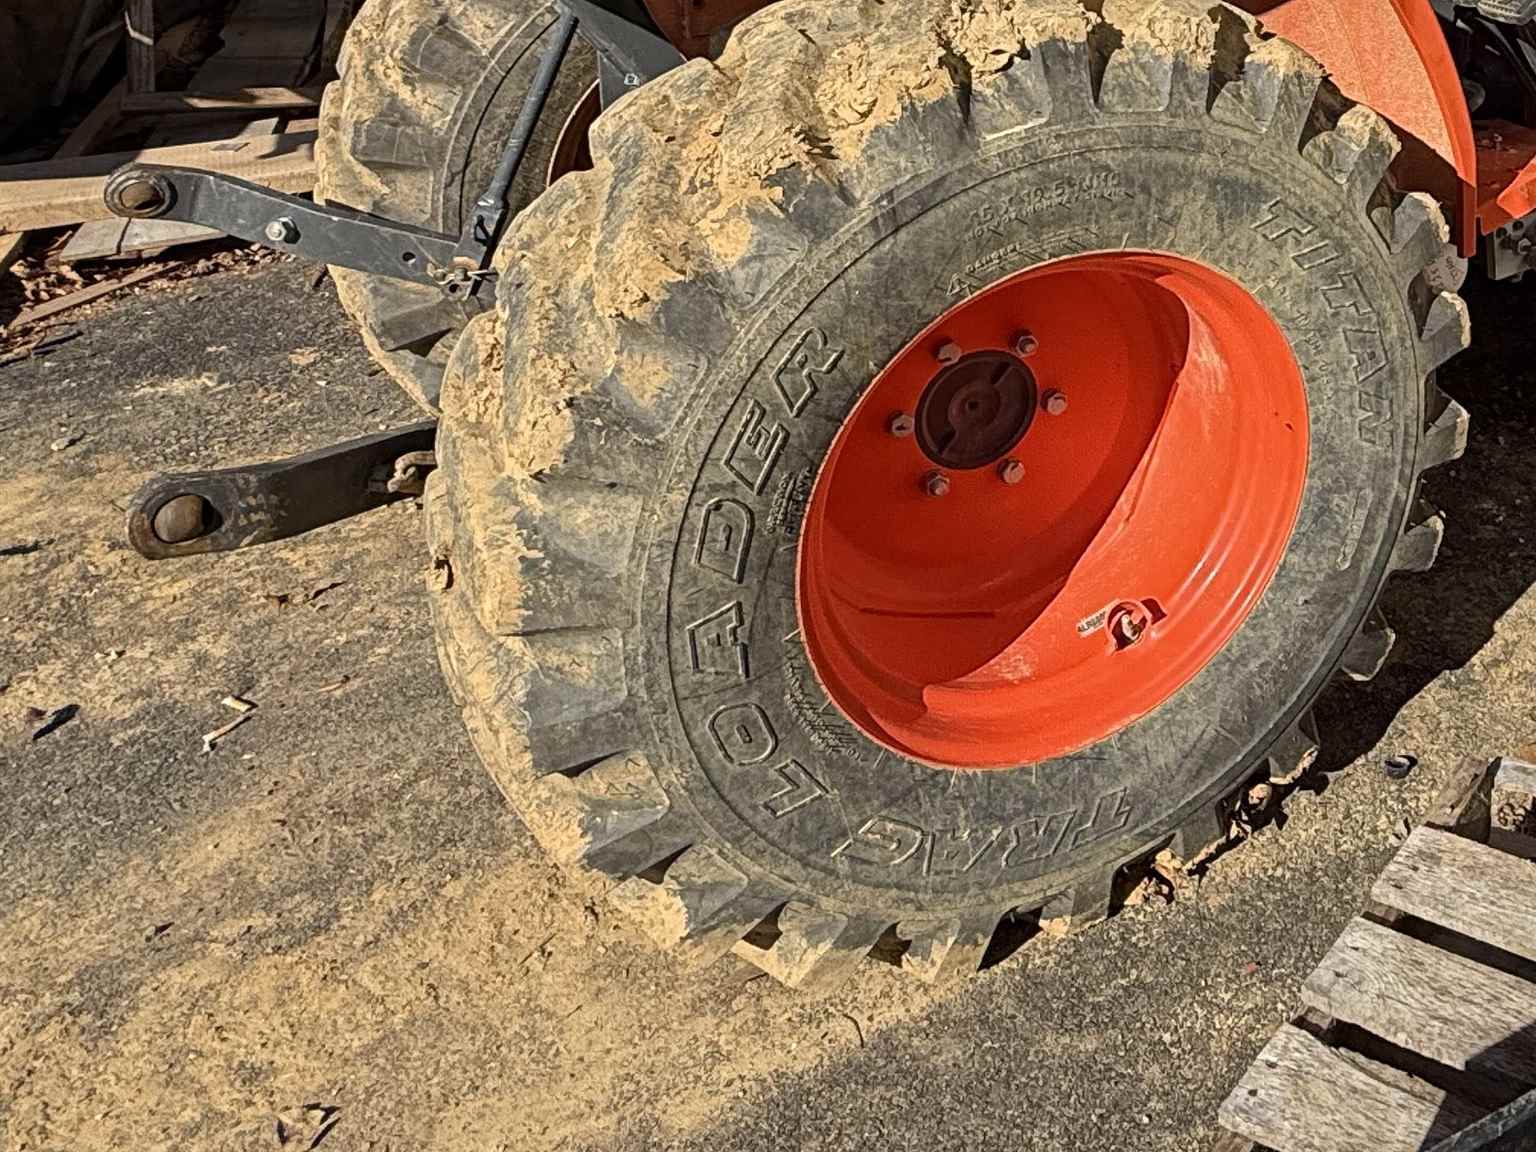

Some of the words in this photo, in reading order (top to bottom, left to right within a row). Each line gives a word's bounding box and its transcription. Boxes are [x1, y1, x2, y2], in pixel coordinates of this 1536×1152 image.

[1250, 197, 1393, 449] TITAN
[686, 325, 844, 819] LOADER
[830, 786, 1134, 877] TRAC
